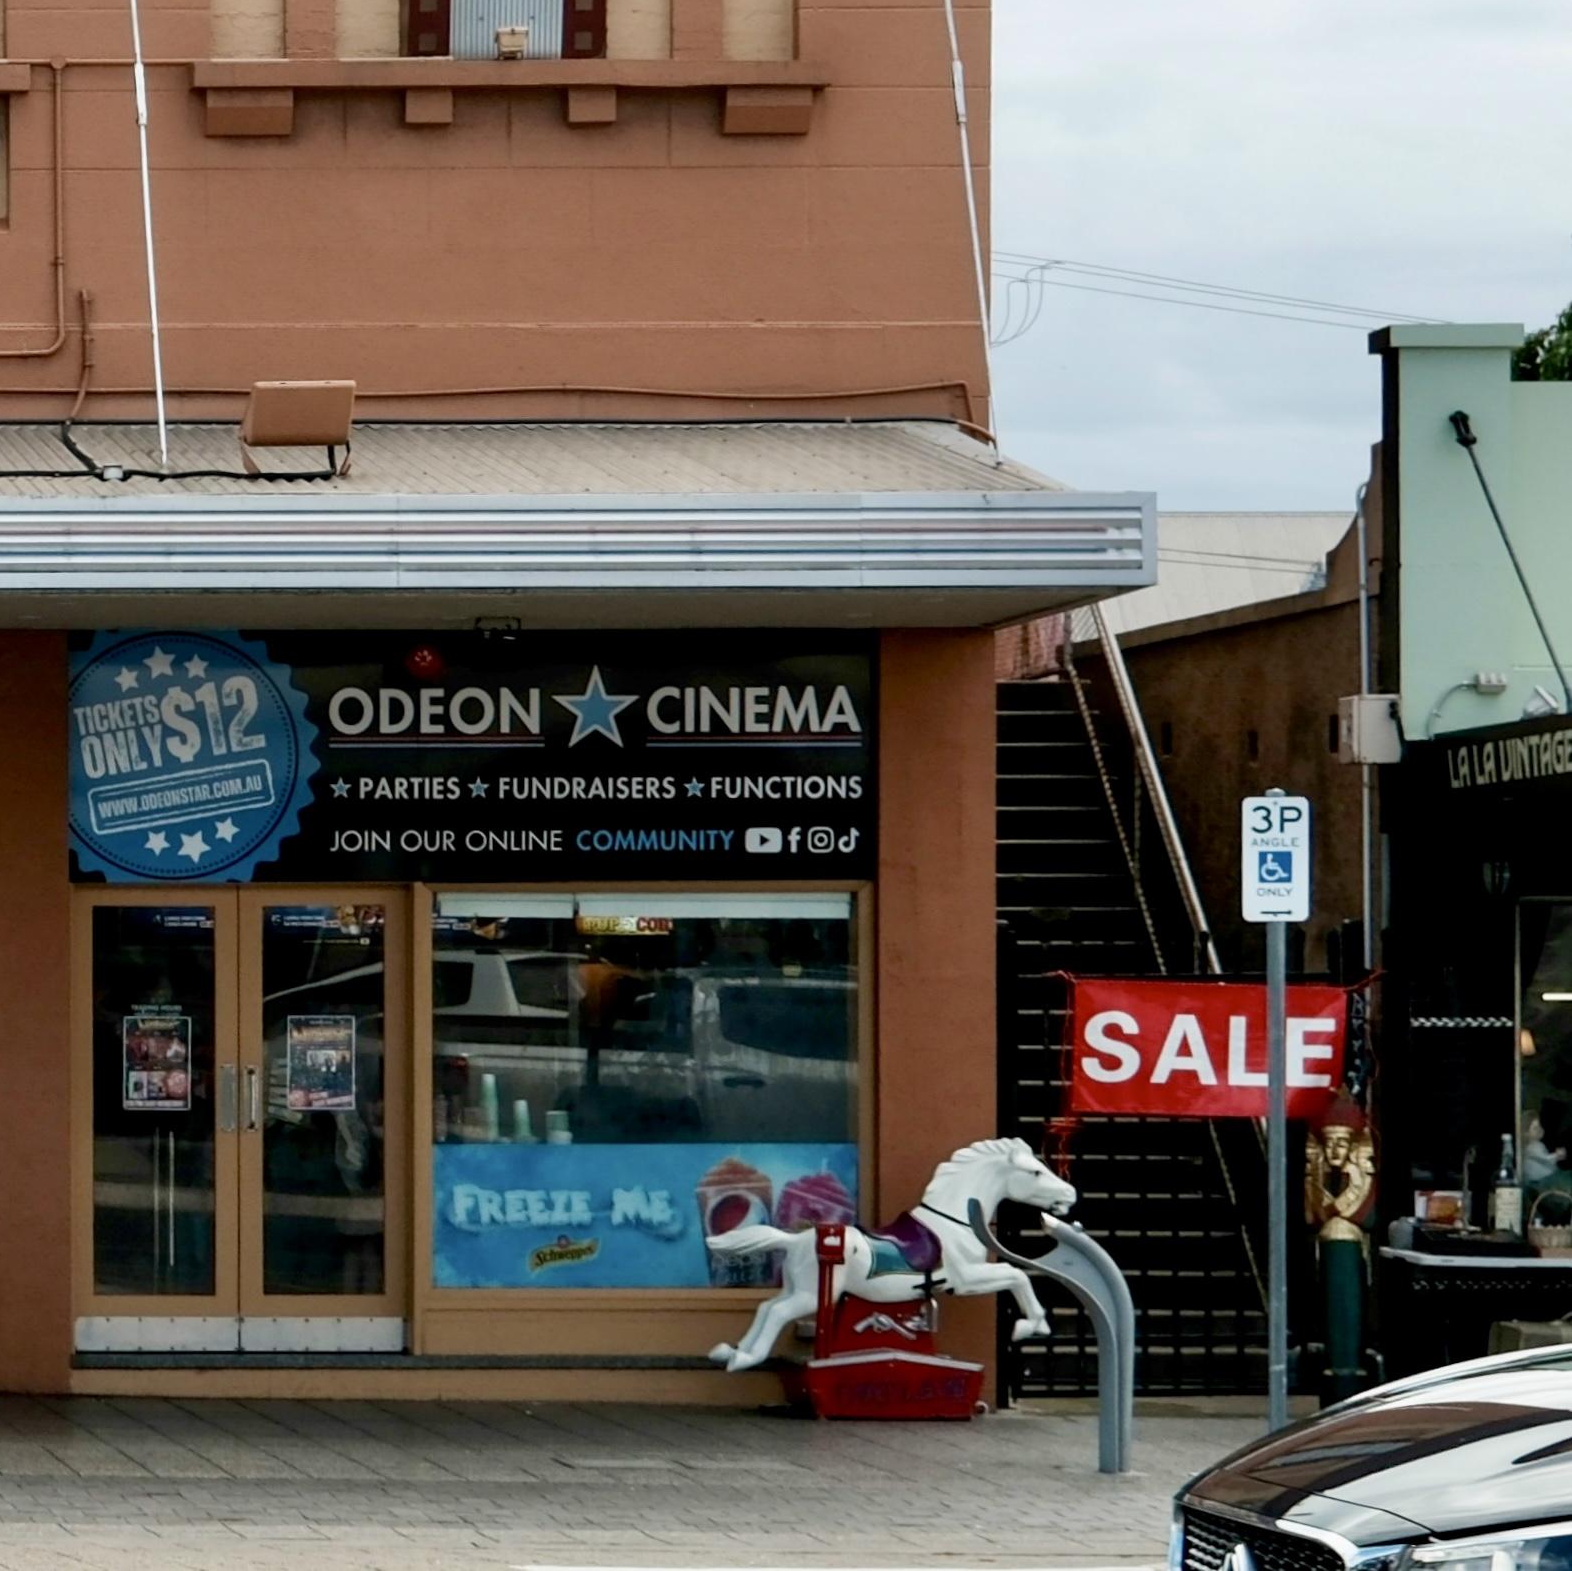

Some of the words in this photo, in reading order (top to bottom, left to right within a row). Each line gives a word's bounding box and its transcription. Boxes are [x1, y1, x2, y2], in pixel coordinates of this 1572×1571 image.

[73, 695, 161, 736] TICKETS
[160, 675, 266, 763] $12
[327, 685, 542, 736] ODEON
[646, 685, 863, 734] CINEMA
[80, 723, 162, 779] ONLY
[1447, 746, 1471, 789] LA
[1472, 741, 1498, 786] LA
[97, 775, 262, 819] WWW.ODEONSTAR.COM.AU
[359, 775, 461, 801] PARTIES
[498, 775, 676, 801] FUNDRAISERS
[710, 774, 863, 800] FUNCTIONS
[1251, 805, 1303, 834] 3P
[330, 830, 393, 854] JOIN
[400, 830, 457, 853] OUR
[465, 830, 563, 853] ONLINE
[576, 830, 735, 853] COMMUNITY
[1251, 837, 1300, 847] ANGLE
[1257, 888, 1293, 897] ONLY
[1081, 1010, 1336, 1088] SALE
[453, 1185, 592, 1227] FREEZE
[610, 1185, 673, 1226] ME
